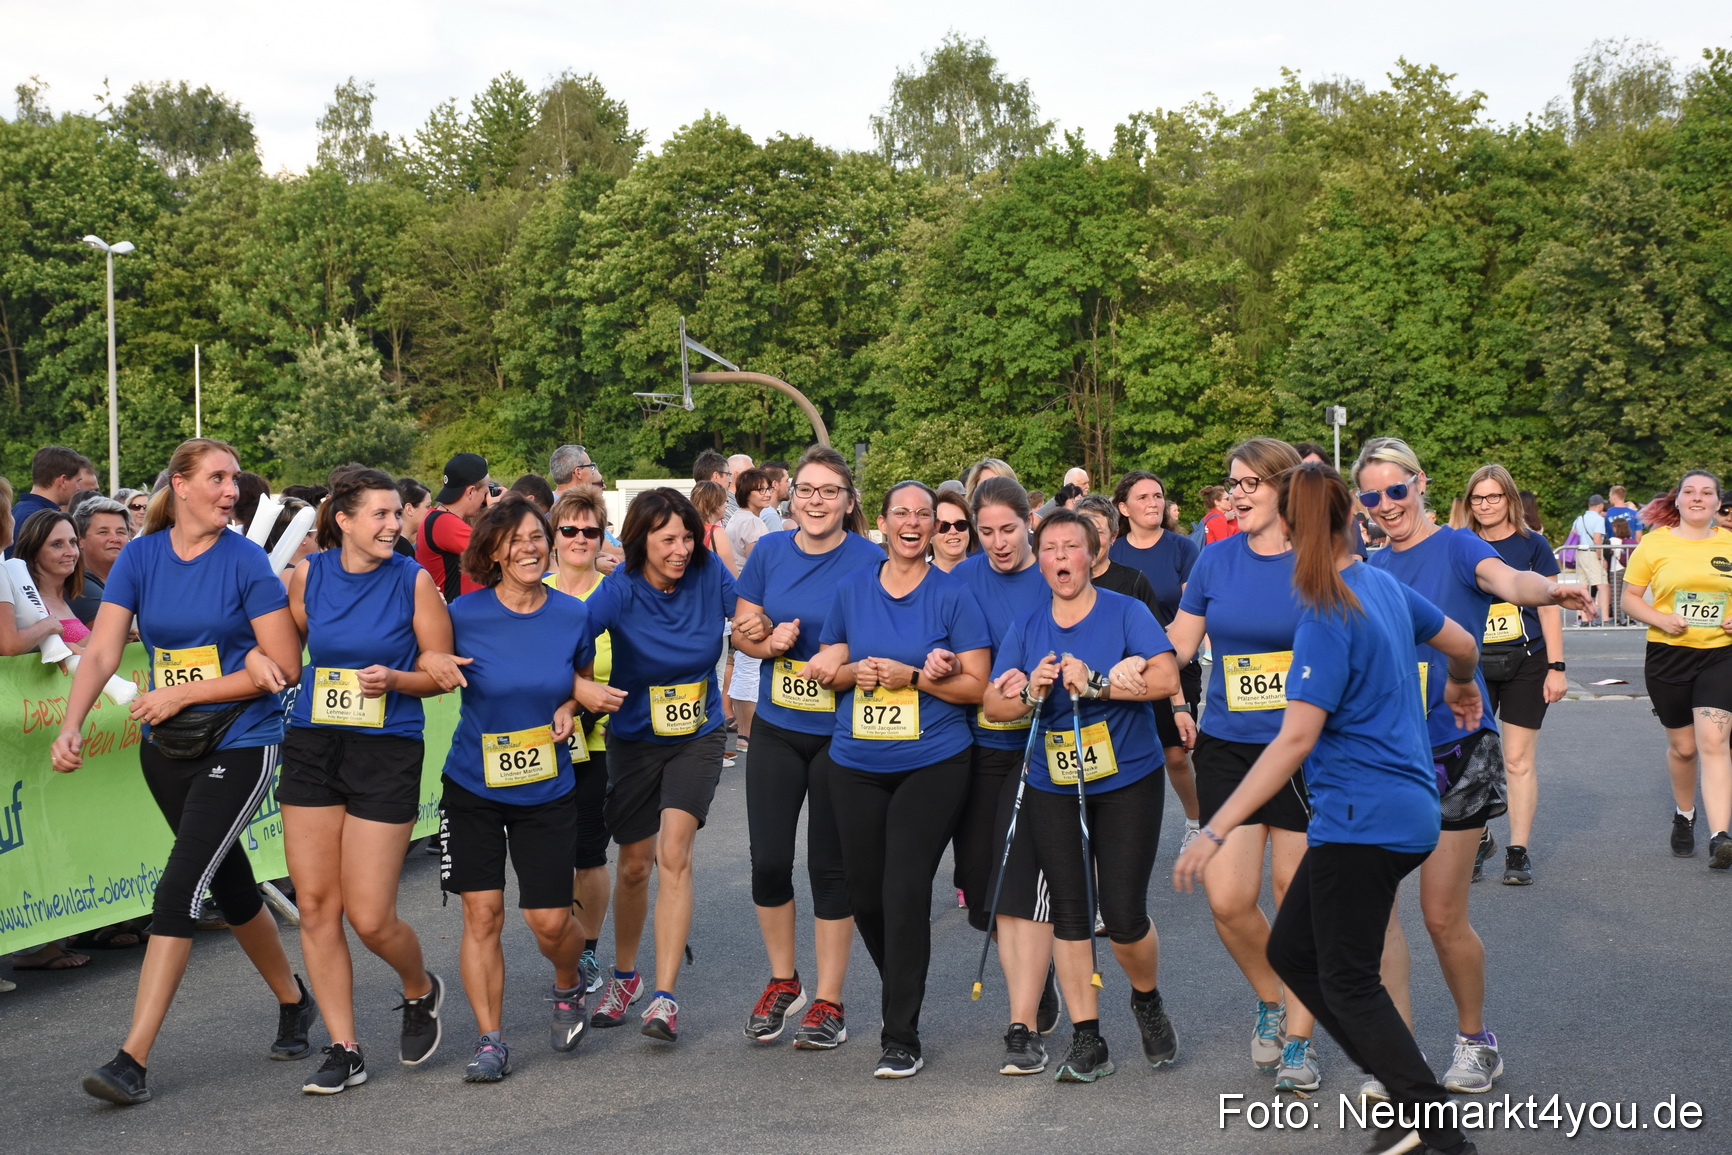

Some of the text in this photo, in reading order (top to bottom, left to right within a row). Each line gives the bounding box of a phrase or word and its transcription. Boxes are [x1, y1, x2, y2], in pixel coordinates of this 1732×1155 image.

[1681, 604, 1720, 618] 1762
[1485, 617, 1508, 631] 12
[164, 668, 204, 687] 856
[782, 676, 819, 697] 868
[1240, 673, 1283, 695] 864
[326, 689, 365, 710] 861
[666, 700, 701, 722] 866
[863, 705, 902, 724] 872
[499, 748, 541, 771] 862
[1056, 746, 1098, 770] 854
[500, 770, 522, 778] Lindner
[263, 819, 284, 841] neu
[0, 862, 164, 934] ww.firmenlauf-oberpfal
